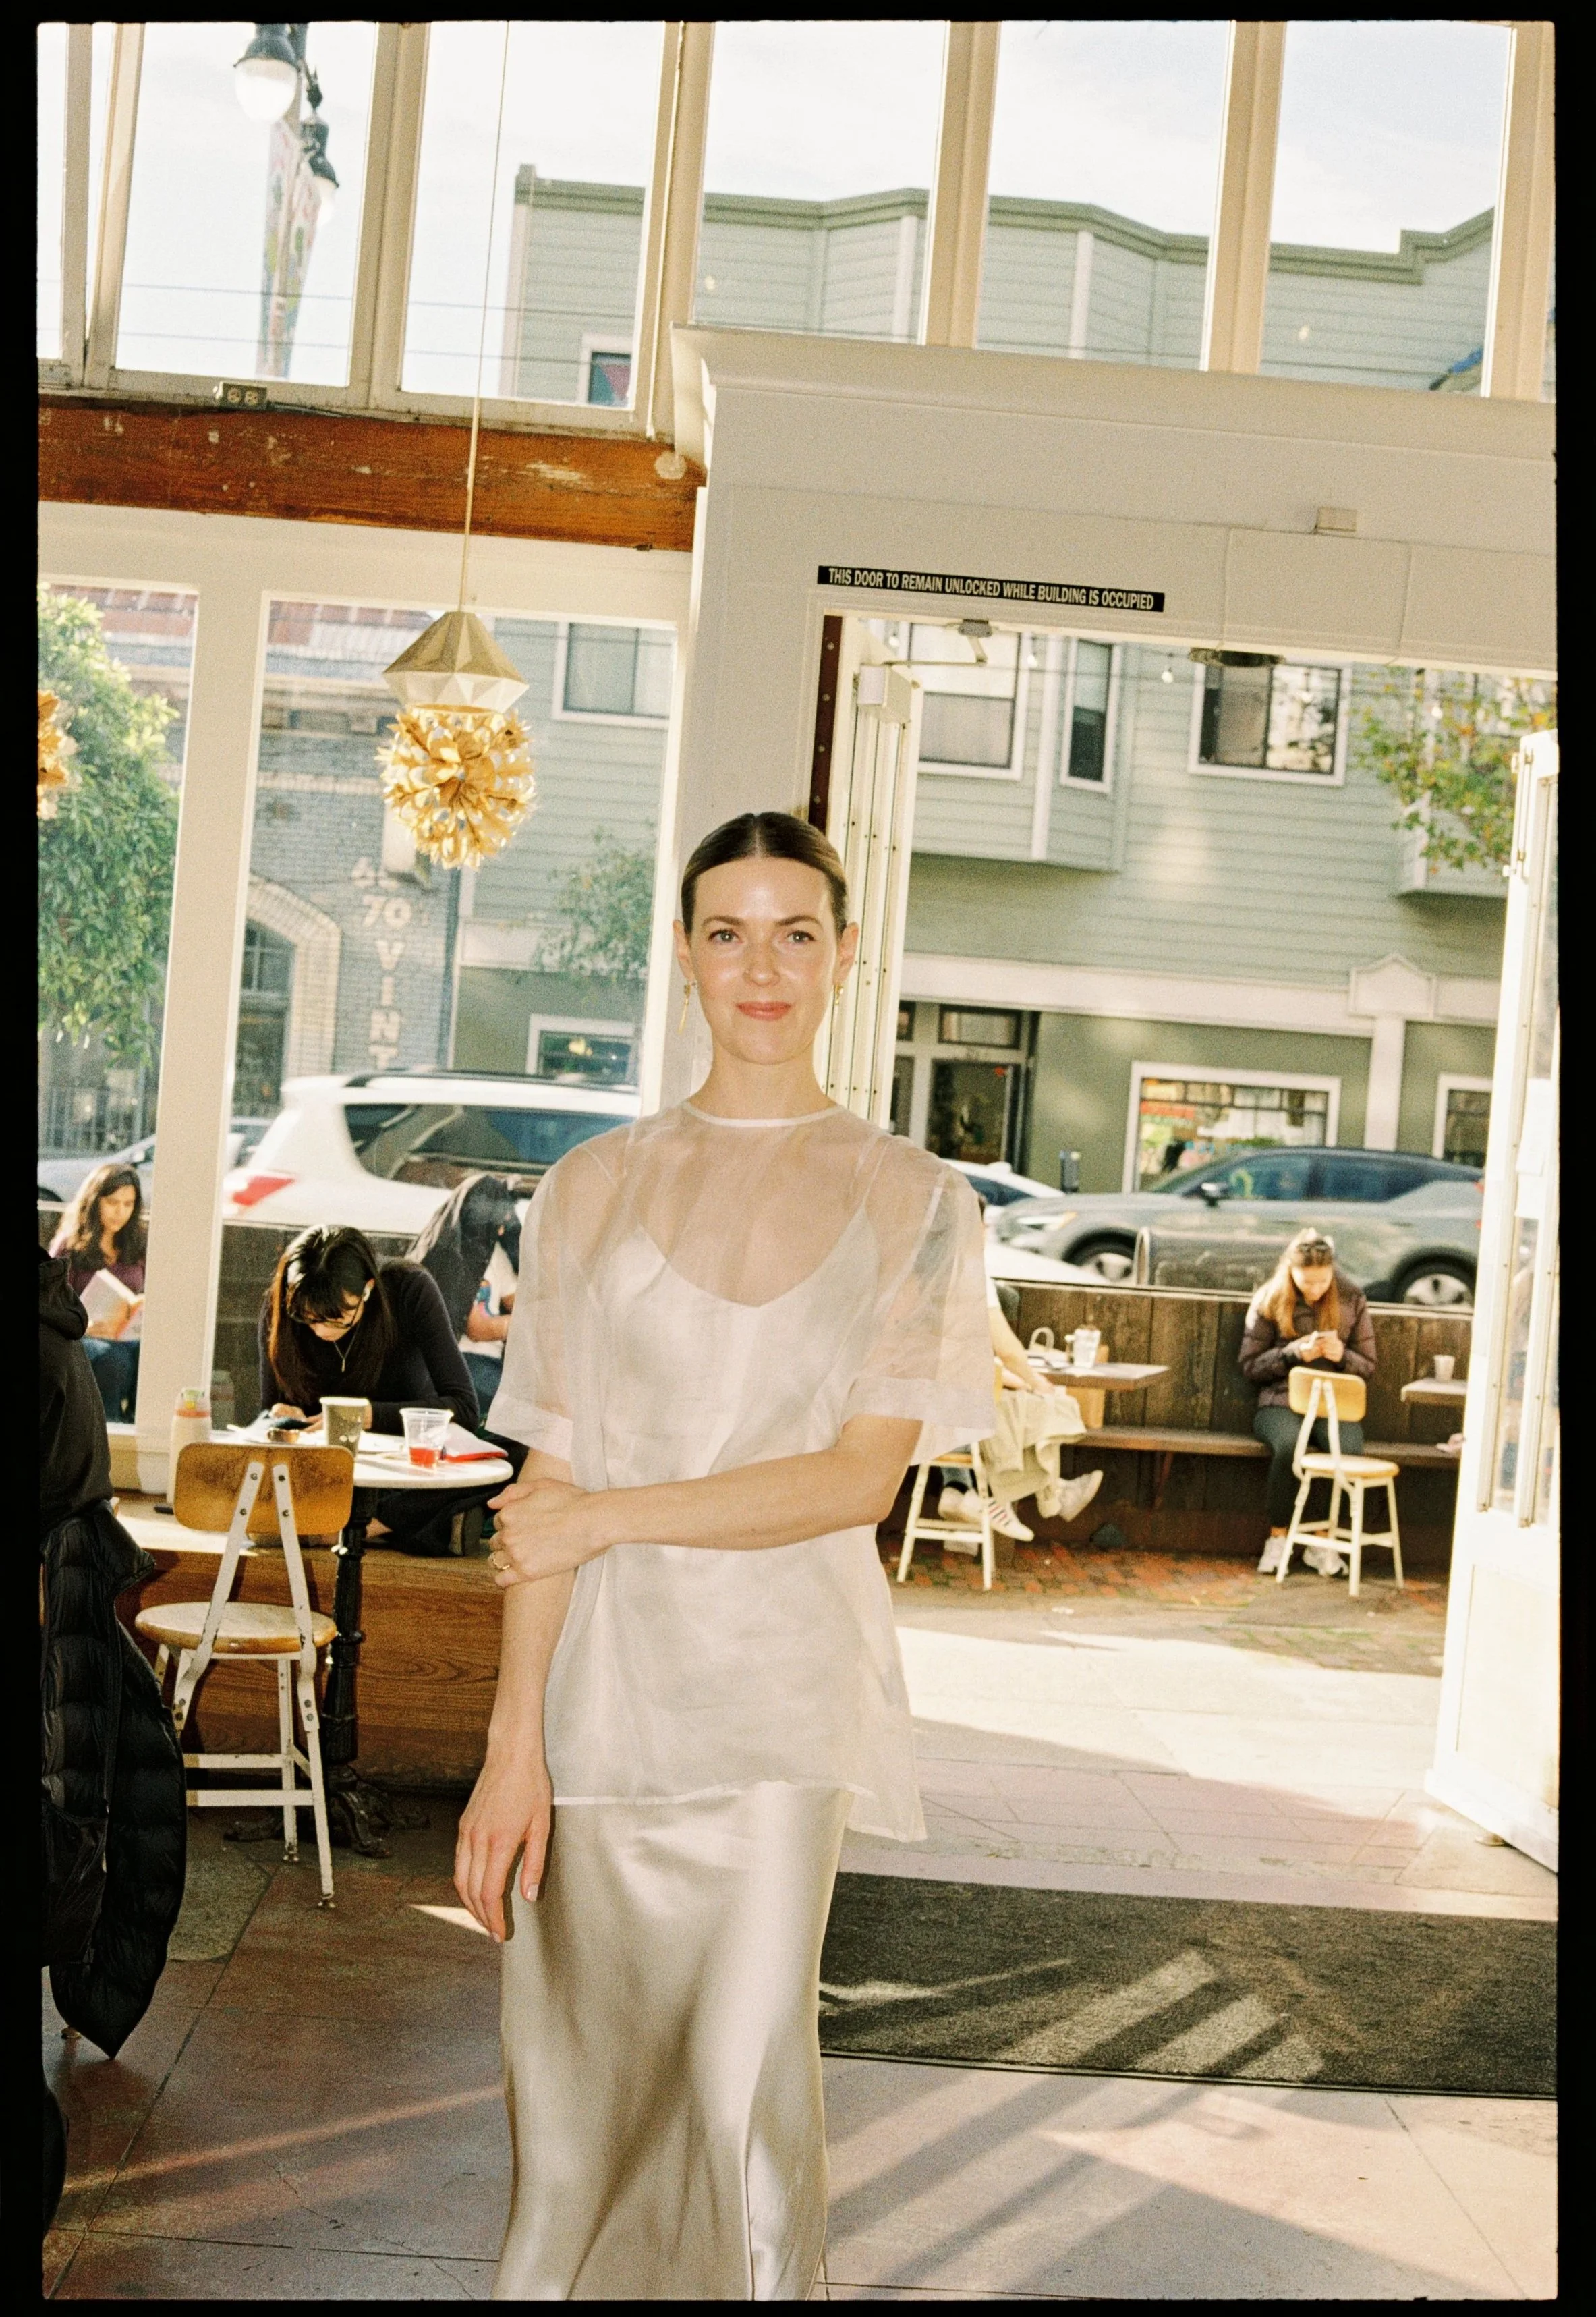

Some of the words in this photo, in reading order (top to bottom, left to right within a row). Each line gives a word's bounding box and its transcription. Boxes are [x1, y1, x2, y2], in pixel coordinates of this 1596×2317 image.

[828, 568, 852, 585] THIS
[854, 570, 884, 588] DOOR
[886, 572, 899, 588] TO
[901, 574, 943, 592] REMAIN
[945, 578, 1000, 597] UNLOCKED
[1003, 582, 1035, 600] WHILE
[1037, 585, 1086, 604] BUILDING
[1089, 590, 1100, 605] IS
[1102, 590, 1154, 610] OCCUPIED
